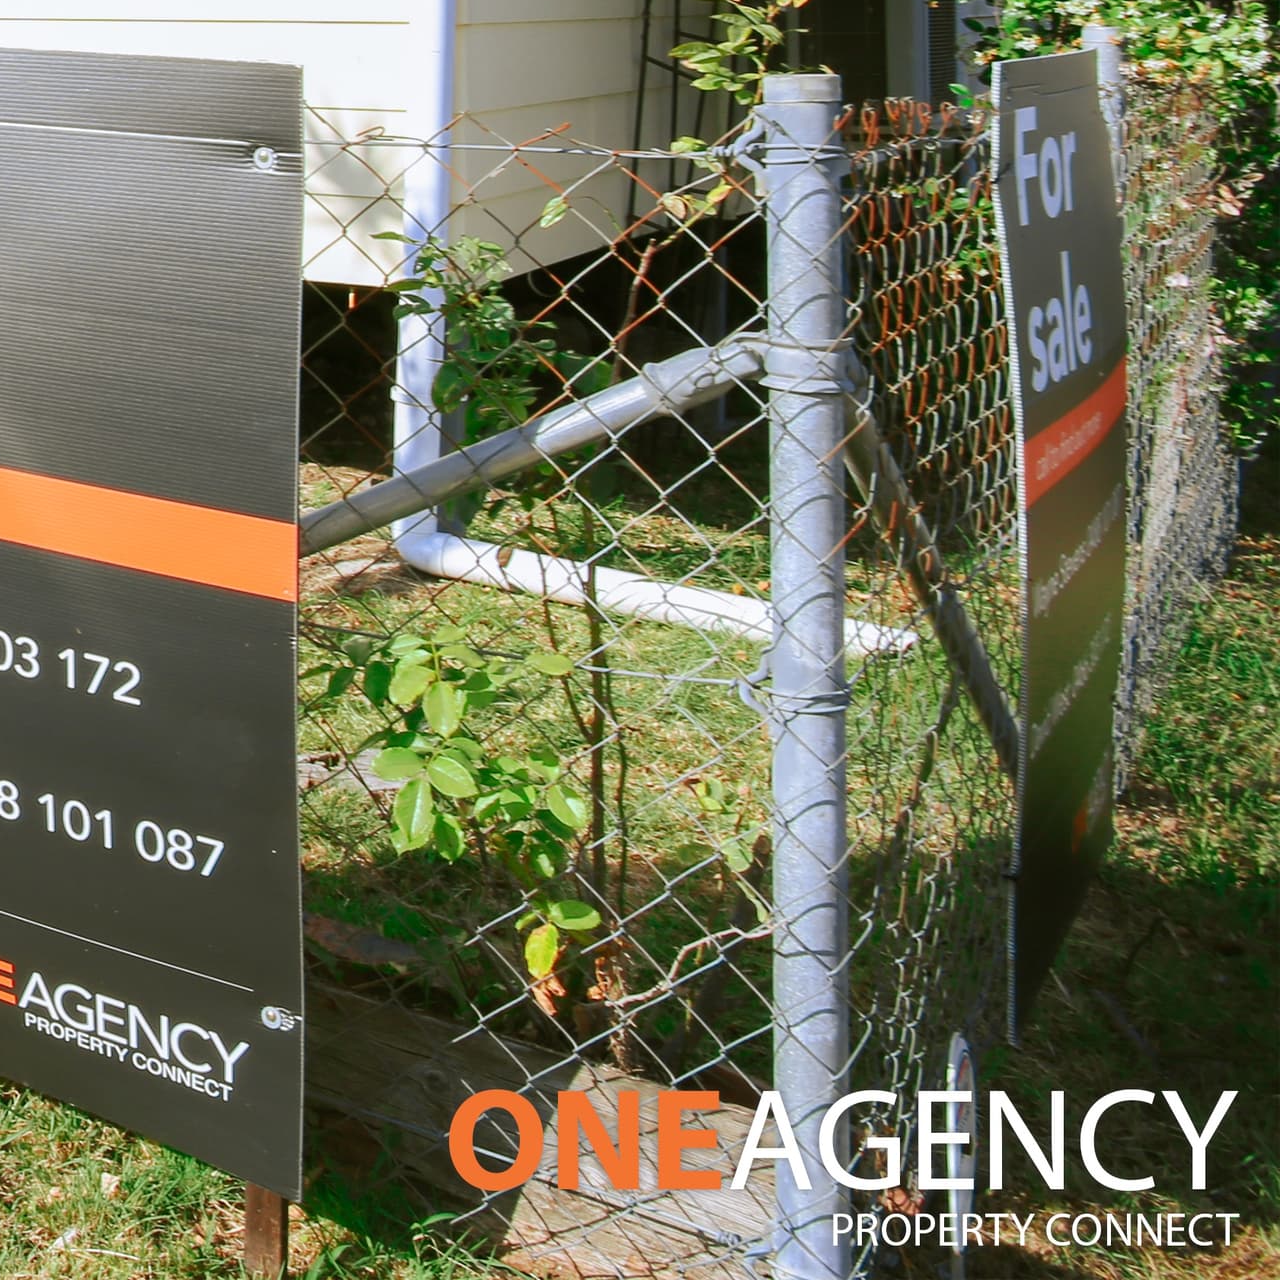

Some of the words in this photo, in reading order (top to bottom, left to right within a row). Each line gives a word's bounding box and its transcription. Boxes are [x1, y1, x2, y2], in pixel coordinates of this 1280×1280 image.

[1014, 106, 1077, 227] For
[1027, 250, 1093, 393] sale
[58, 648, 142, 706] 172
[37, 793, 112, 849] 101
[135, 820, 225, 877] 087
[24, 1011, 129, 1063] PROPERTY
[131, 1051, 234, 1102] CONNECT
